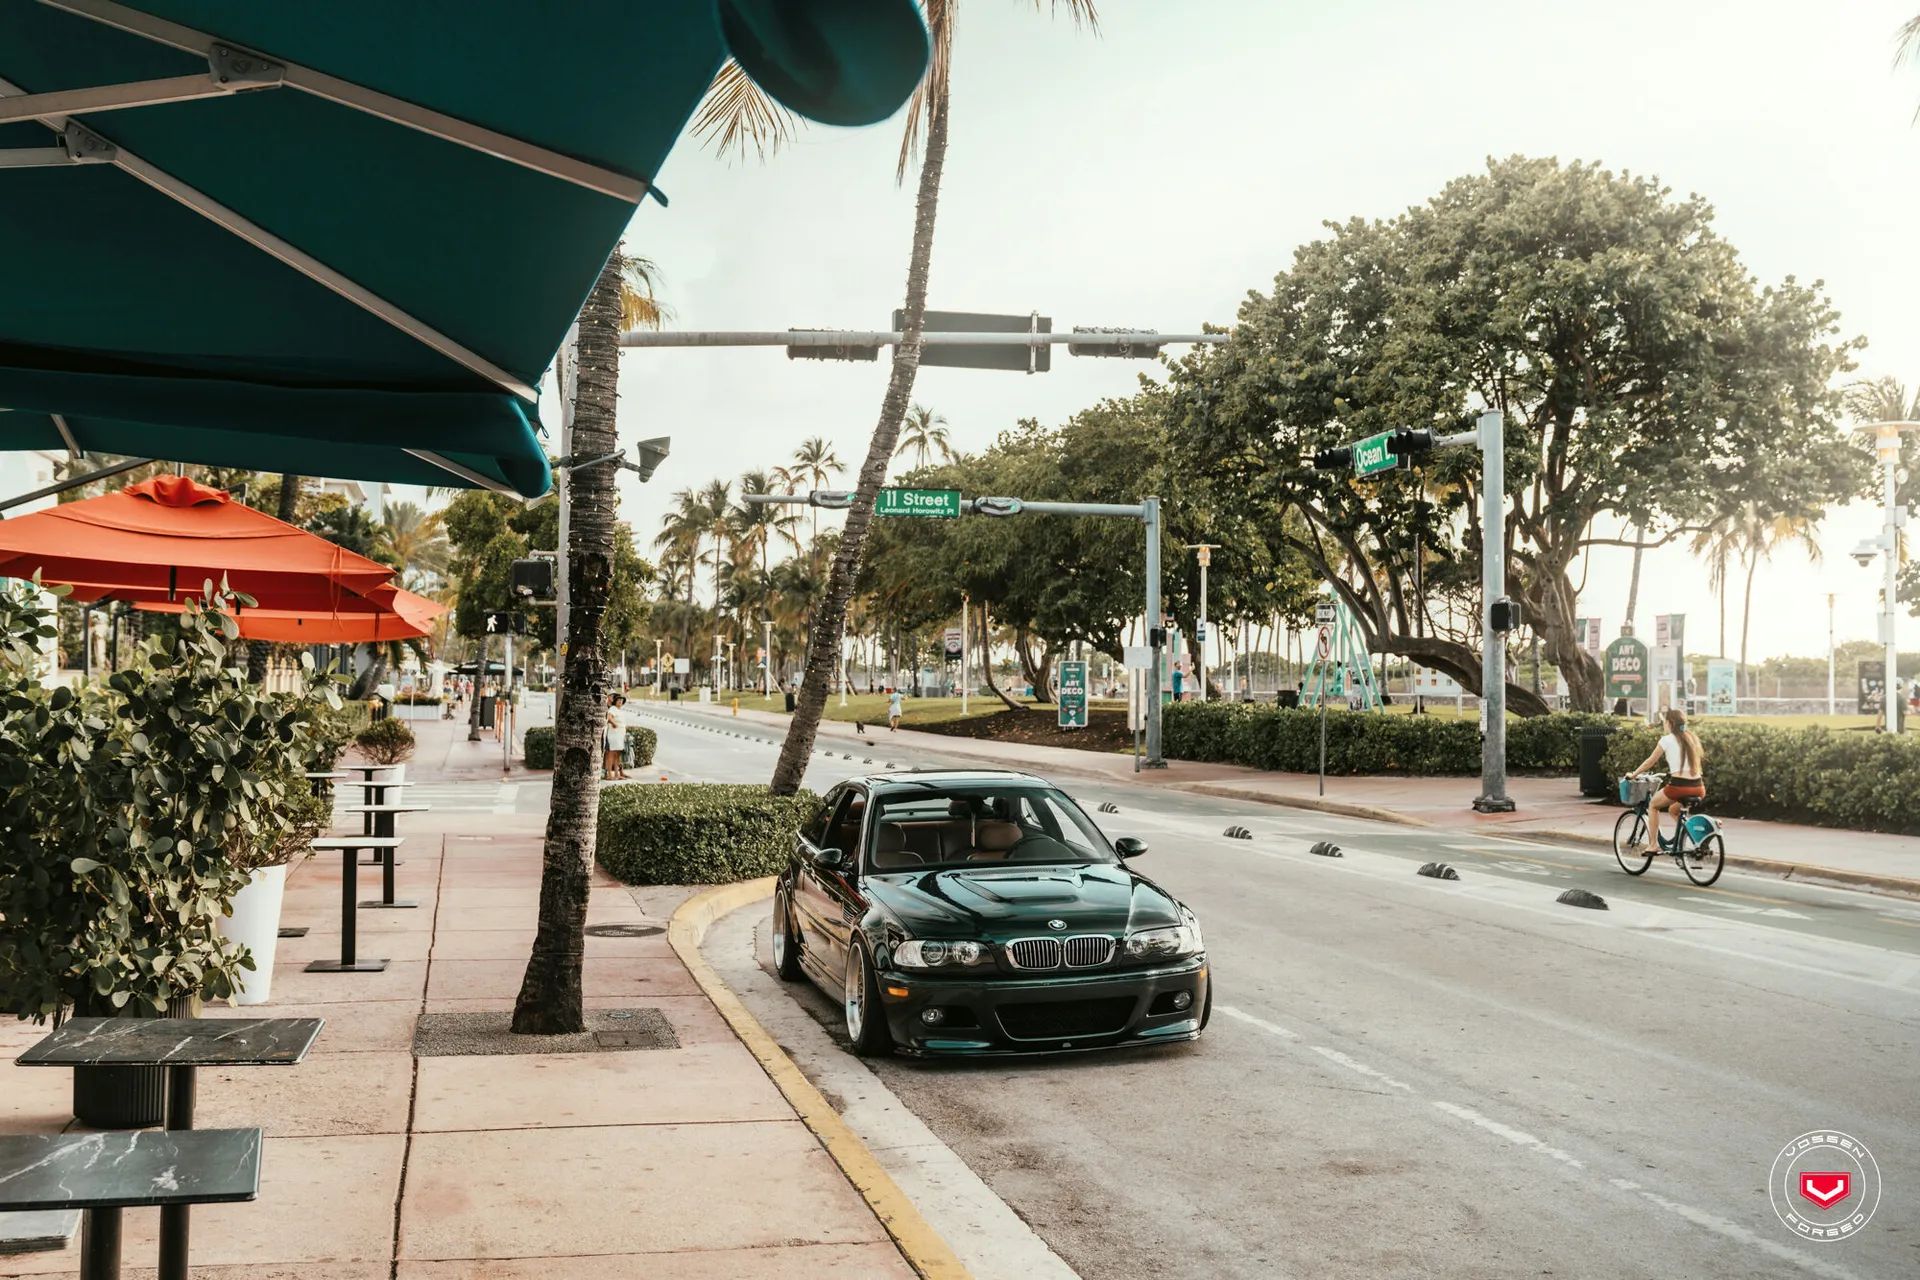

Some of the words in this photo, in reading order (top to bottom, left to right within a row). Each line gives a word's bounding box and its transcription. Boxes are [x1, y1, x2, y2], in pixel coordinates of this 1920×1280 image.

[1356, 445, 1383, 468] Ocean
[886, 490, 897, 507] 11
[903, 492, 949, 506] Street
[912, 507, 944, 515] Horowitz
[1618, 644, 1635, 655] ART
[1612, 657, 1640, 672] DECO
[1061, 687, 1084, 695] DECO
